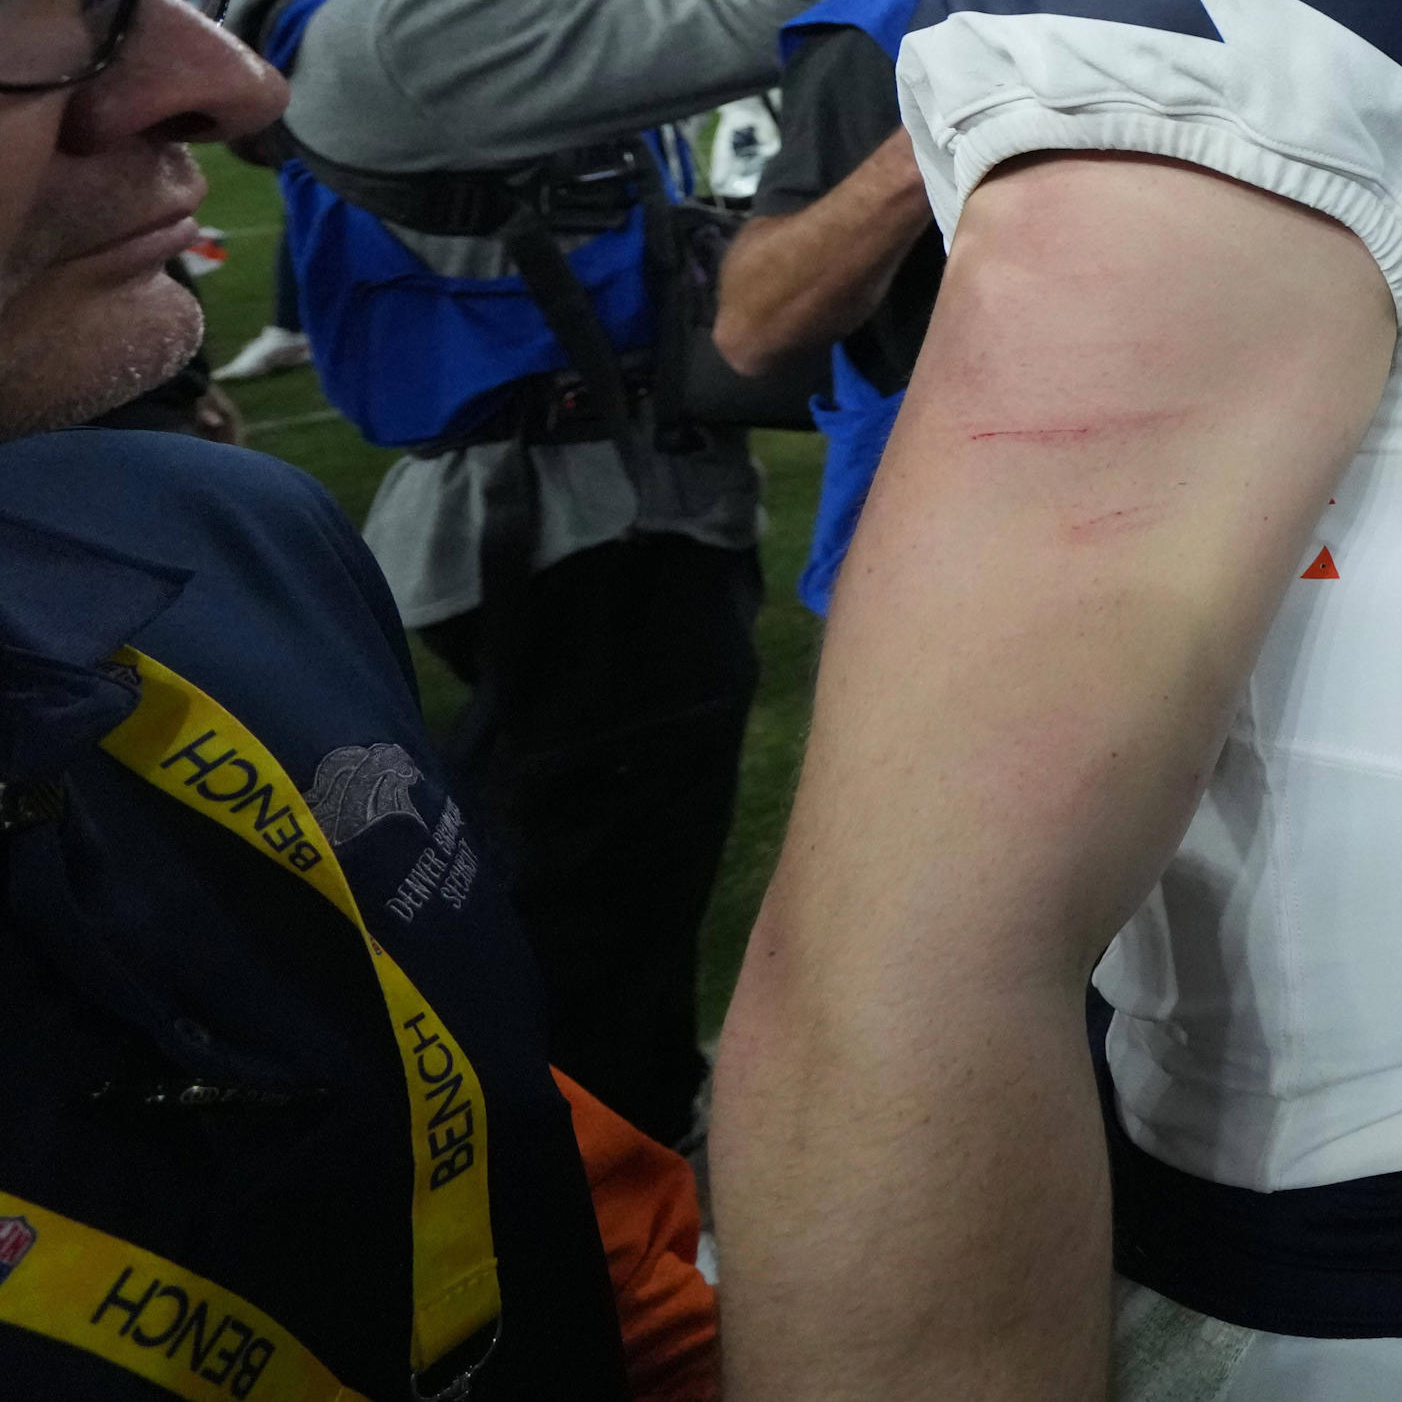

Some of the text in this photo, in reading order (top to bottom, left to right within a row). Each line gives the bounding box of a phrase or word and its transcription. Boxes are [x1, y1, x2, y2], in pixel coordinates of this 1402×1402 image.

[160, 729, 323, 872] BENCH
[385, 846, 448, 923] DENVER
[403, 1011, 474, 1191] BENCH
[90, 1266, 276, 1401] BENCH
